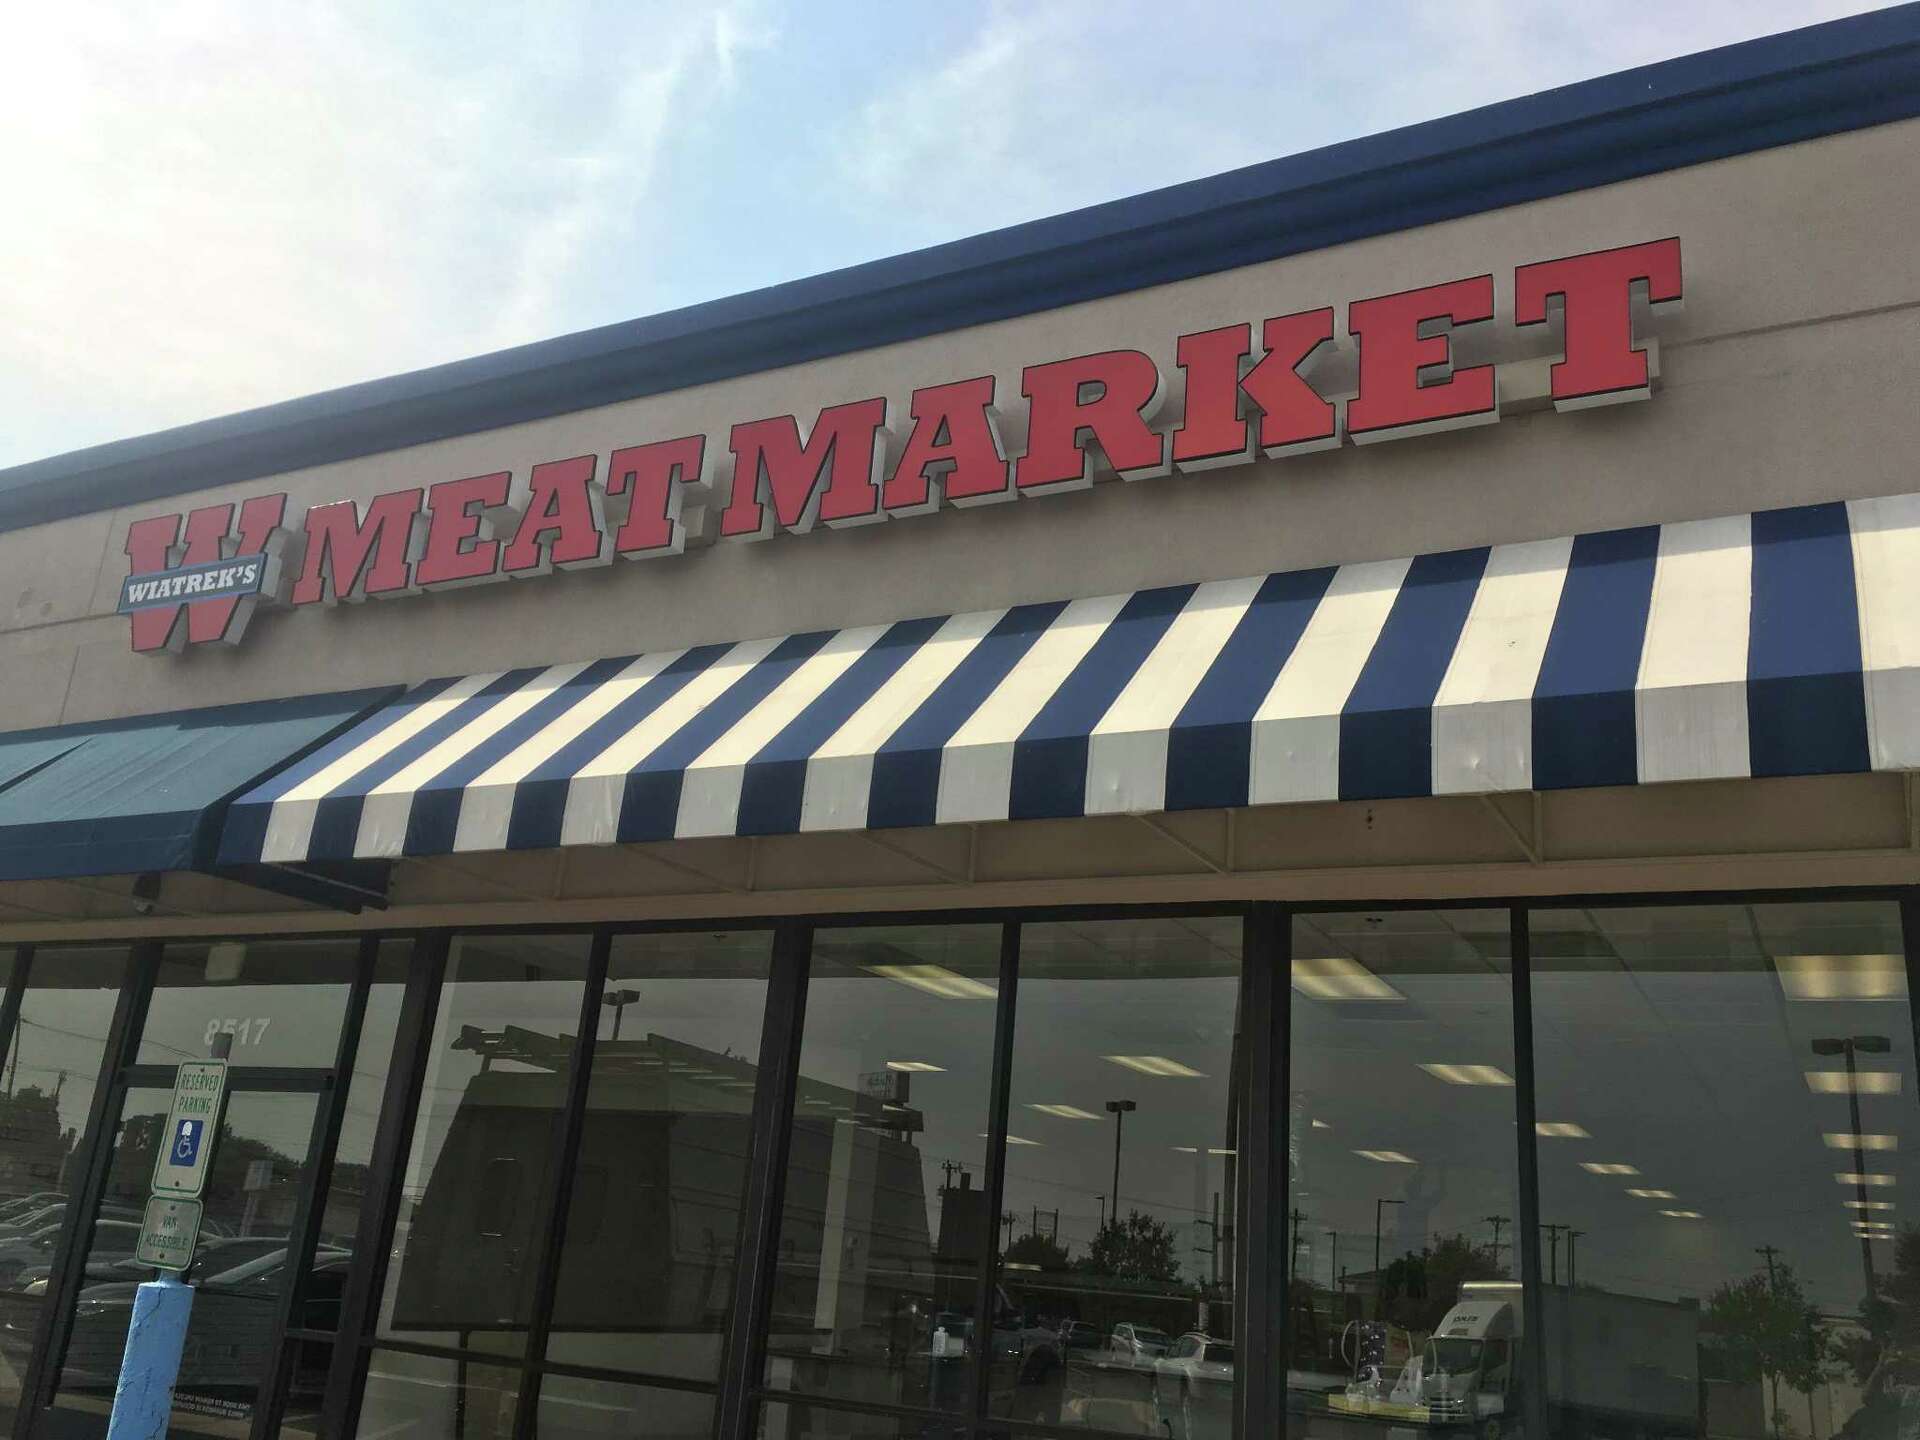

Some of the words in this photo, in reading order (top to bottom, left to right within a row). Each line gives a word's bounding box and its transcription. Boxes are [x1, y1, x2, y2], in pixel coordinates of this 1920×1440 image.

[291, 434, 707, 605] MEAT
[720, 237, 1683, 537] MARKET
[128, 564, 257, 603] WIATREK'S
[180, 1073, 220, 1092] RESERVED
[178, 1096, 212, 1113] PARKING
